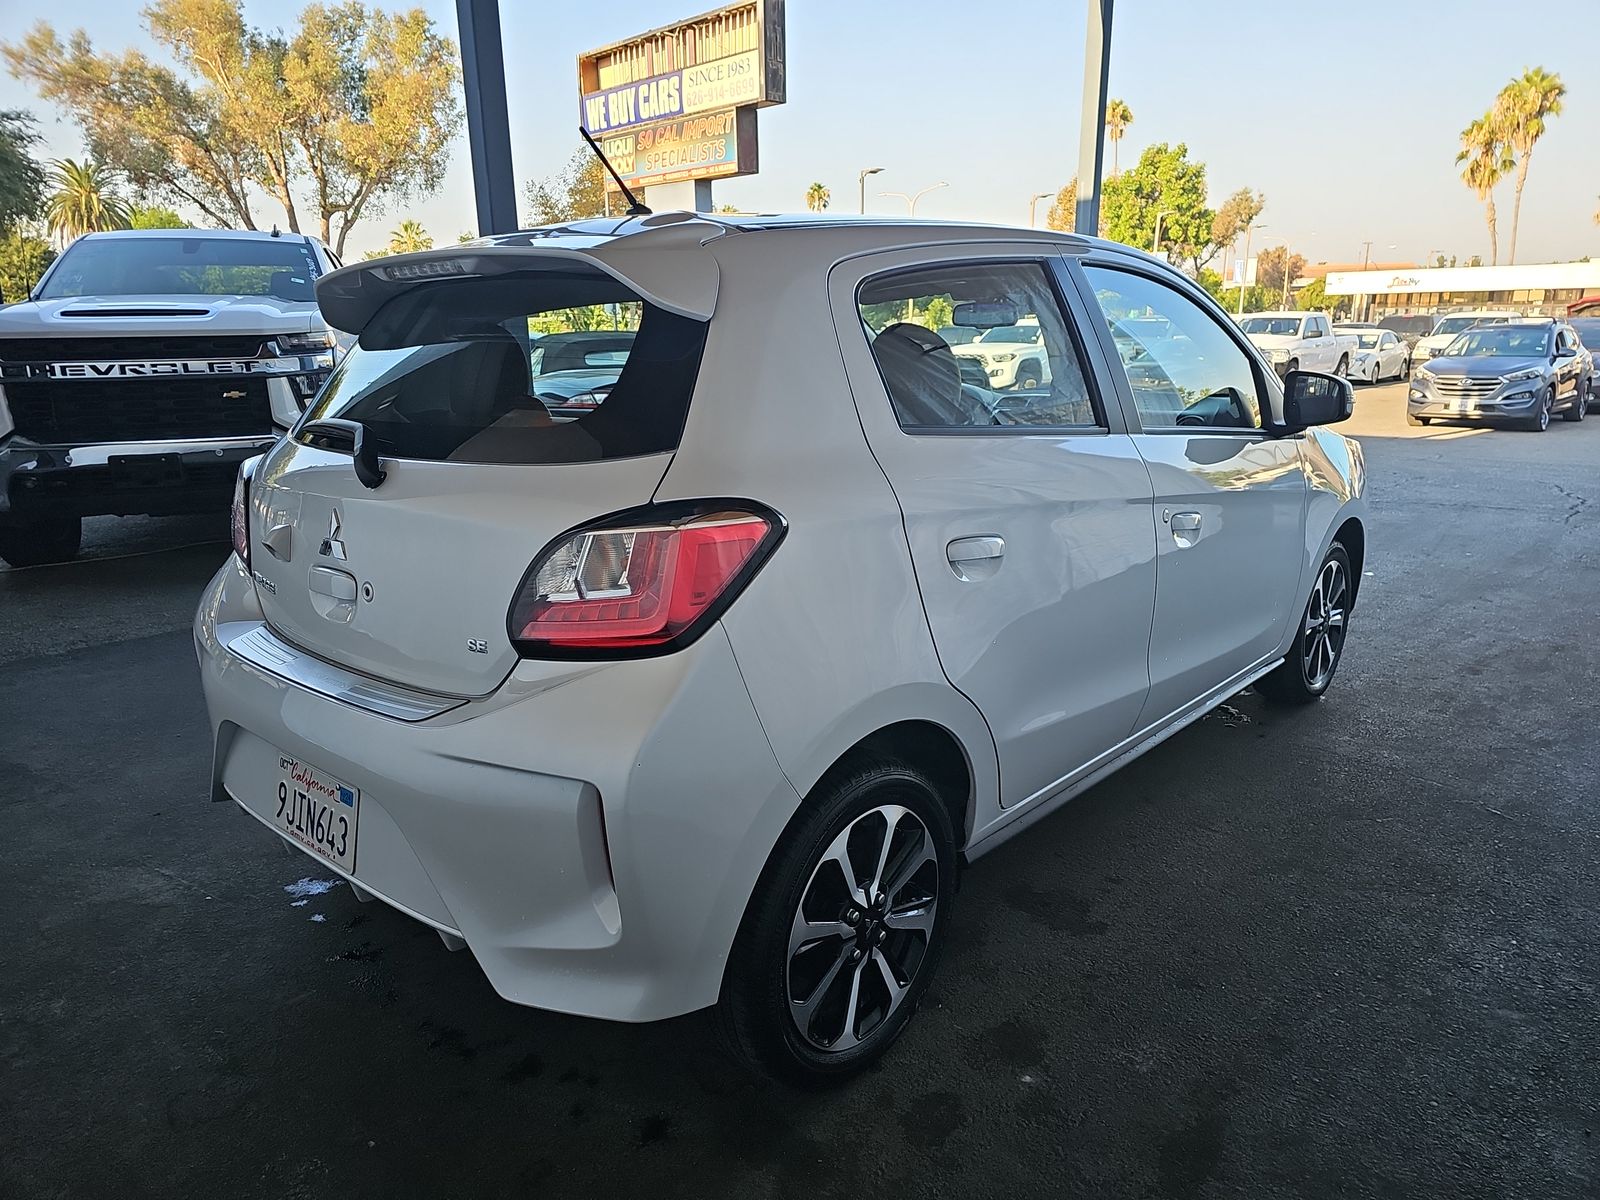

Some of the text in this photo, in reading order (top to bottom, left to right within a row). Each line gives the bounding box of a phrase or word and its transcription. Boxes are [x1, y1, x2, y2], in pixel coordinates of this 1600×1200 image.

[688, 57, 751, 87] SINCE 1983
[585, 76, 680, 132] WE BUY CARS
[606, 137, 634, 157] LIQUI
[637, 113, 734, 150] SO CAL IMPORT
[645, 139, 725, 172] SPECIALISTS
[467, 638, 488, 654] SE
[291, 762, 340, 803] California
